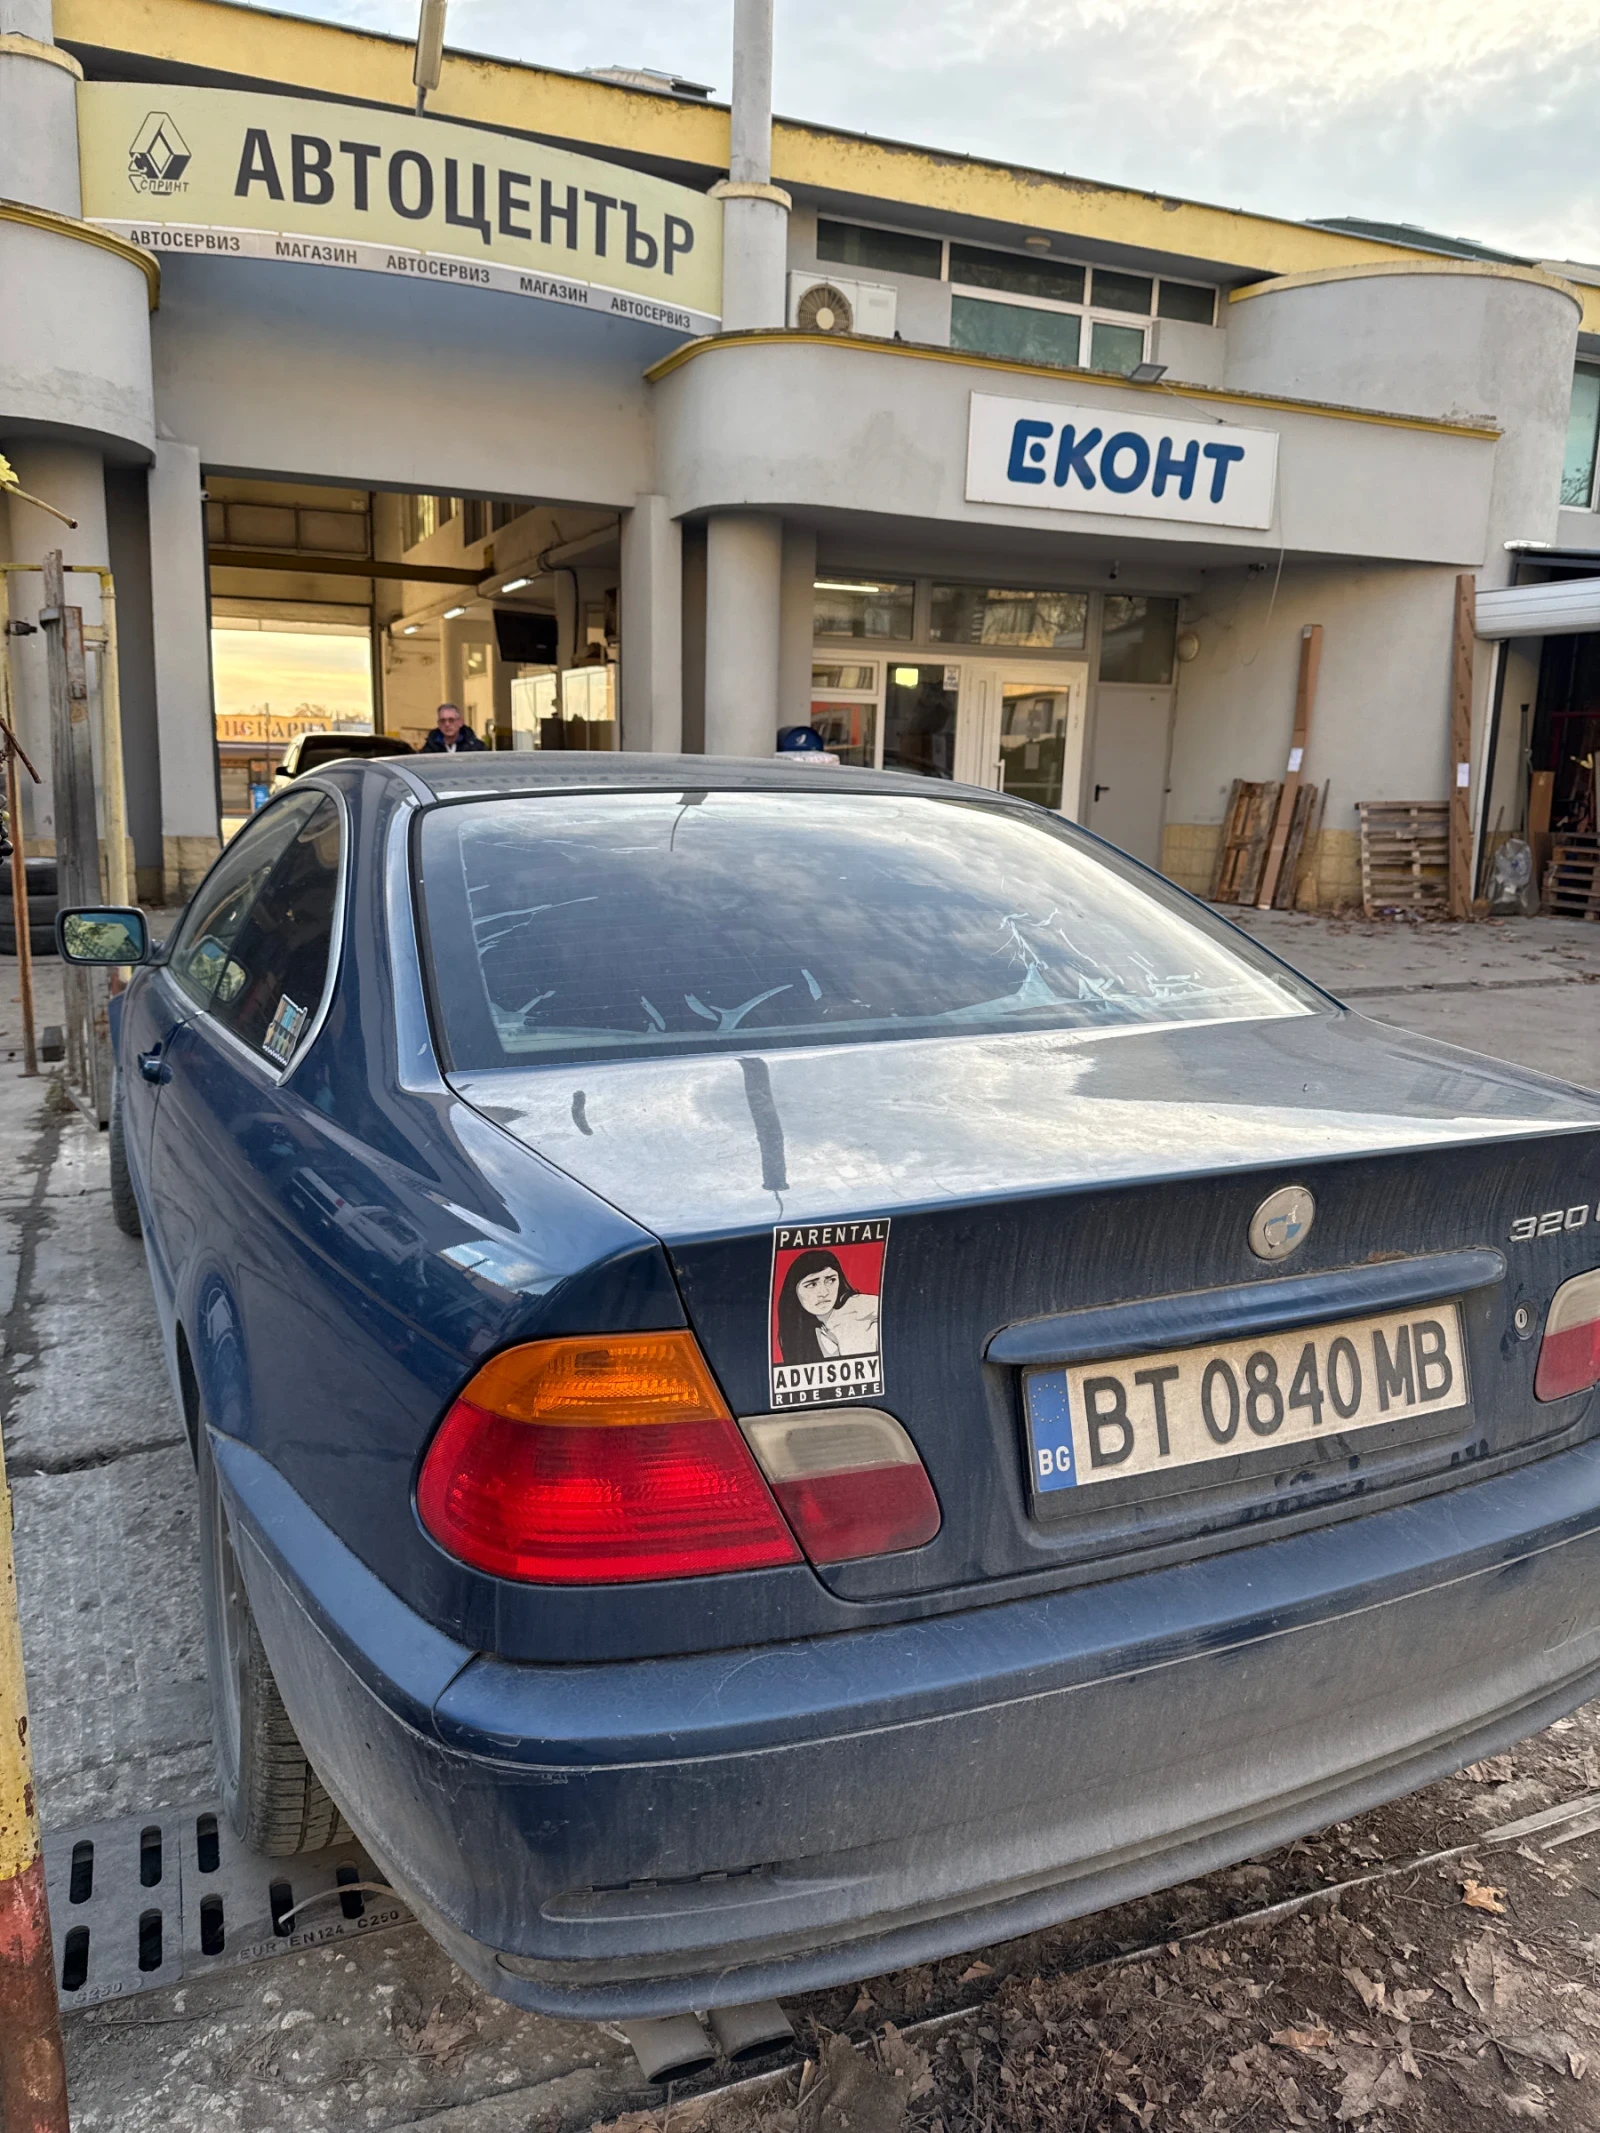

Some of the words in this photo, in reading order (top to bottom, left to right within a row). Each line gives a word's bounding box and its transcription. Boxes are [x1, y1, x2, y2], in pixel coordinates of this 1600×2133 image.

[139, 179, 190, 193] СПРИНТ
[234, 127, 695, 276] АВТОЦЕНТЪР
[130, 230, 240, 251] АВТОСЕРВИЗ
[275, 241, 358, 265] МАГАЗИН
[386, 255, 490, 283] АВТОСЕРВИЗ
[520, 277, 588, 304] МАГАЗИН
[610, 297, 691, 329] АВТОСЕРВИЗ
[1007, 418, 1245, 504] ЕКОНТ
[779, 1224, 884, 1247] PARENTAL
[775, 1359, 878, 1390] ADVISORY
[775, 1389, 820, 1405] RIDE
[835, 1382, 880, 1398] SAFE
[1201, 1336, 1362, 1445] 0840
[1038, 1445, 1071, 1476] BG
[357, 1910, 399, 1929] C250
